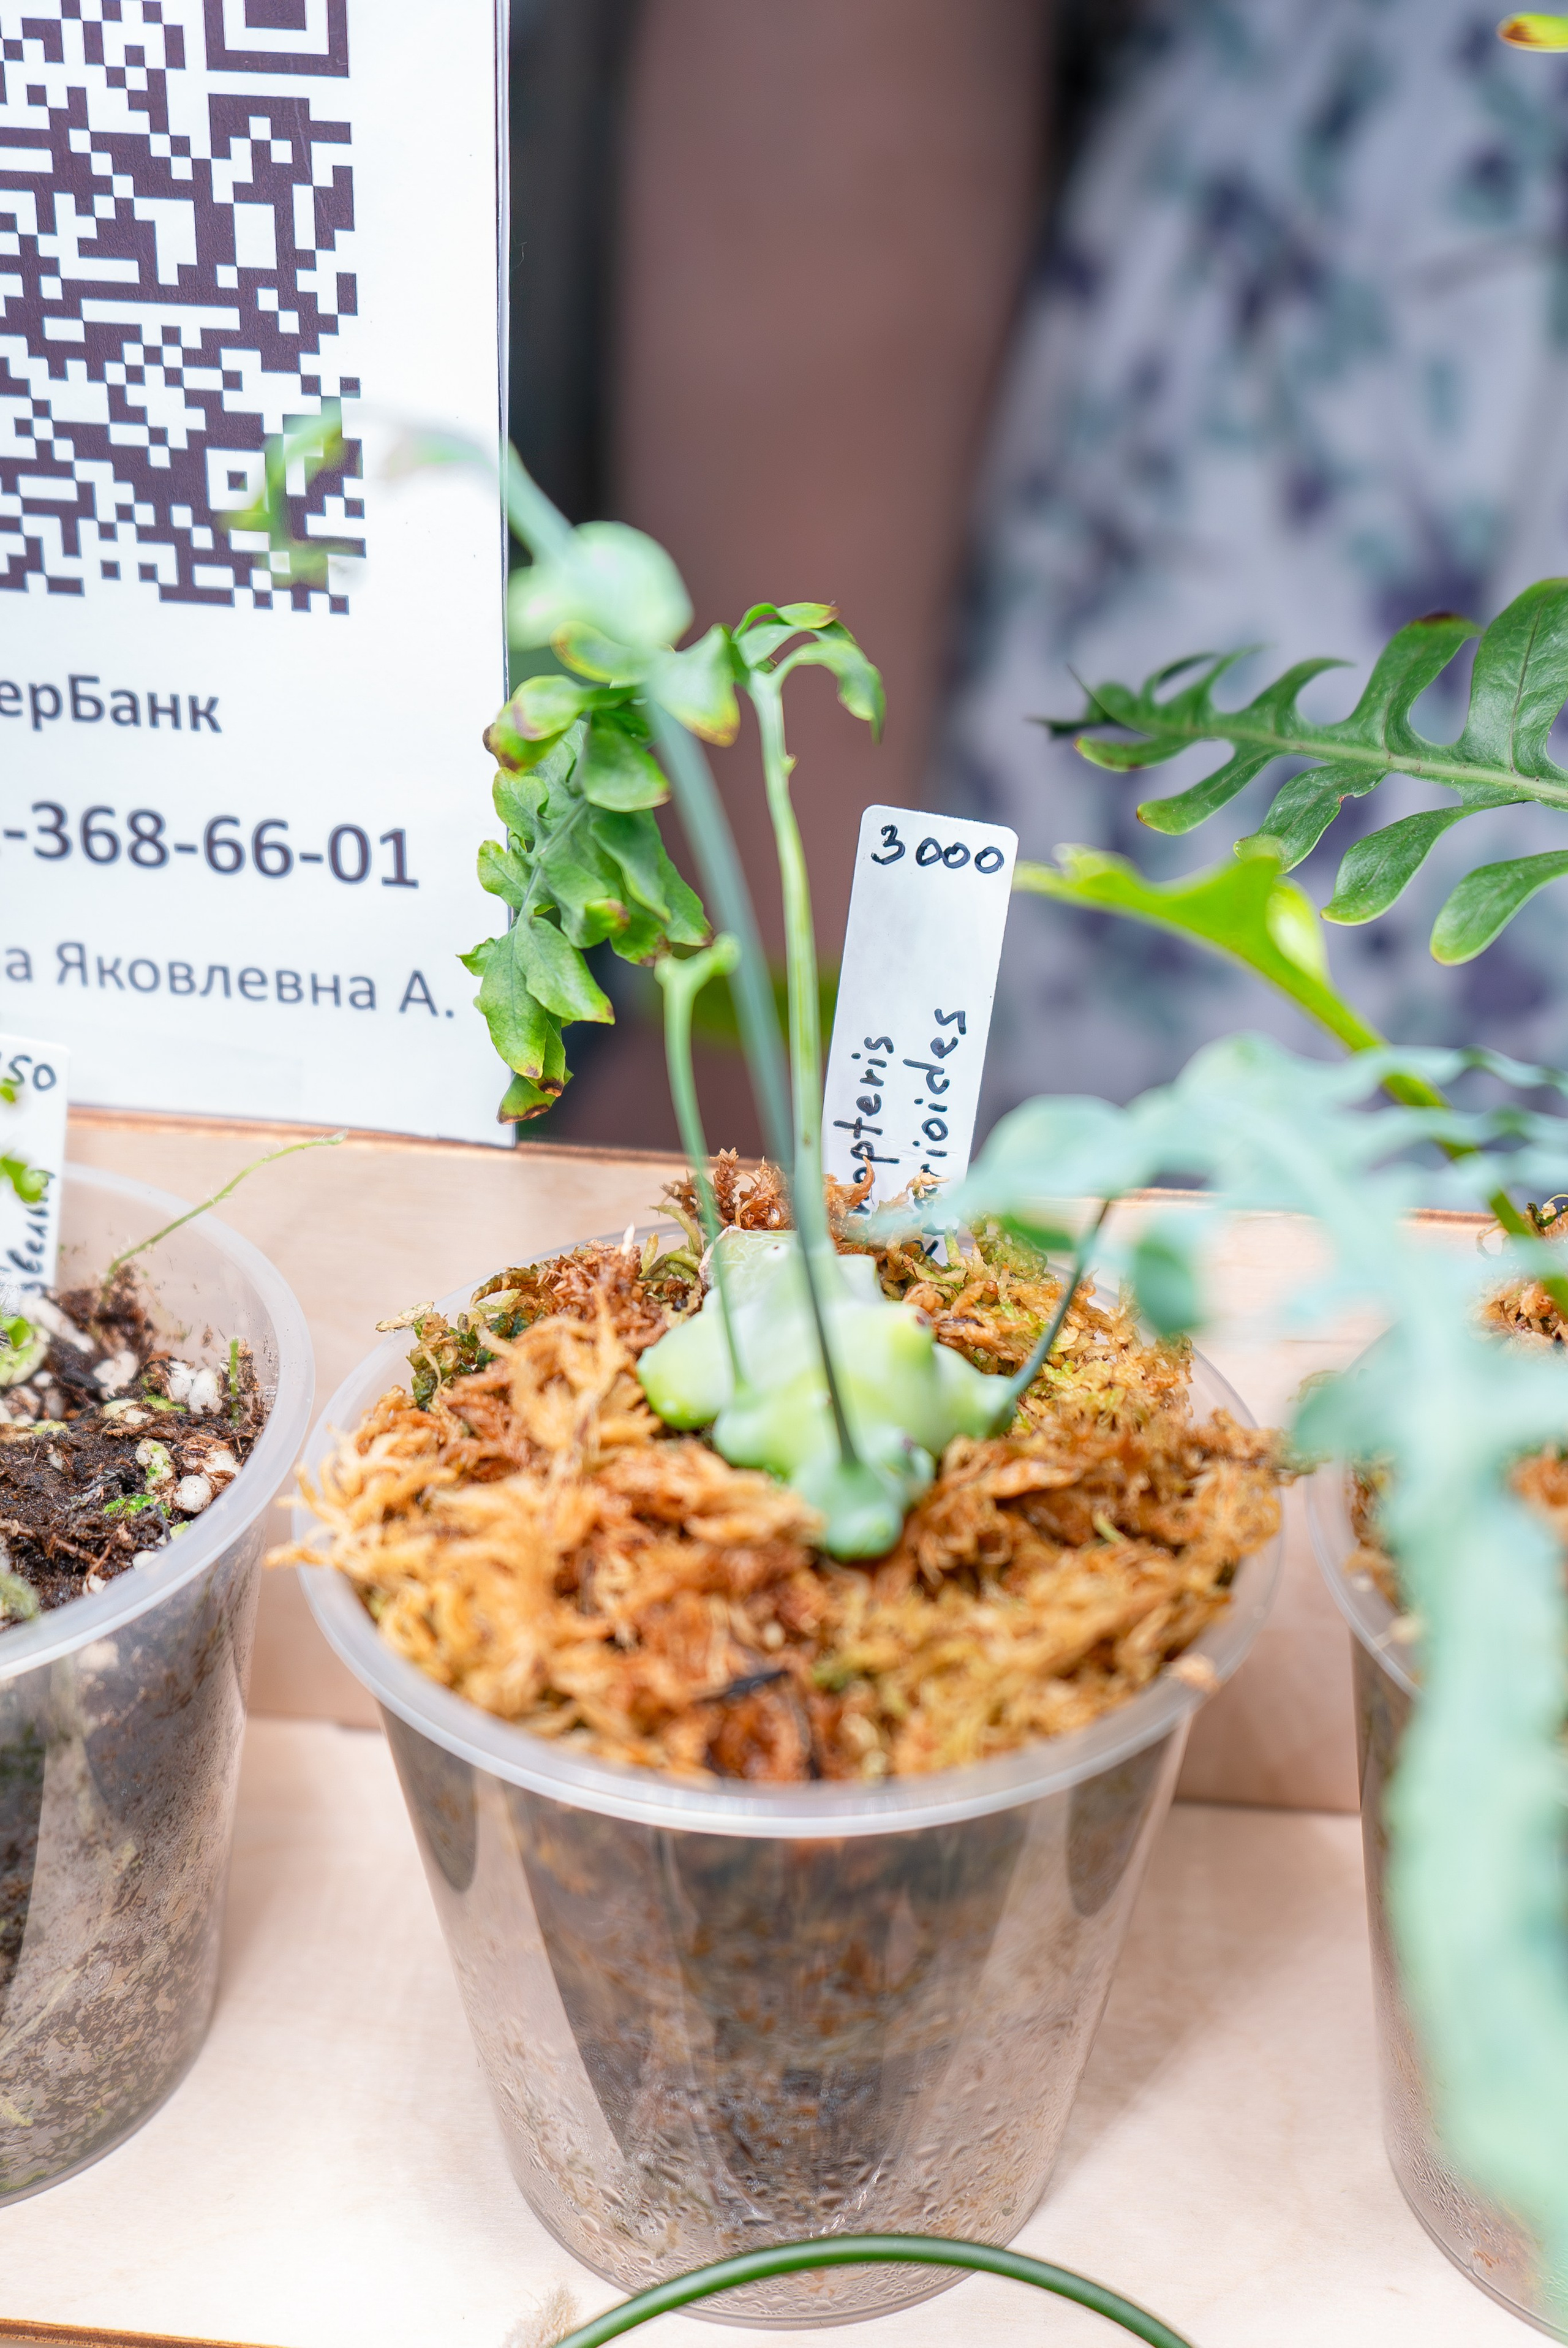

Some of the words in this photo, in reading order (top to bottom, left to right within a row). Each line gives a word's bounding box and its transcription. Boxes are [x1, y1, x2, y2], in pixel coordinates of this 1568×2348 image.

[0, 673, 222, 733] ерБанк
[4, 801, 420, 889] -368-66-01
[871, 825, 1005, 874] 3000
[56, 942, 377, 1011] Яковлевна
[398, 970, 455, 1019] А.
[834, 1036, 900, 1215] opteris
